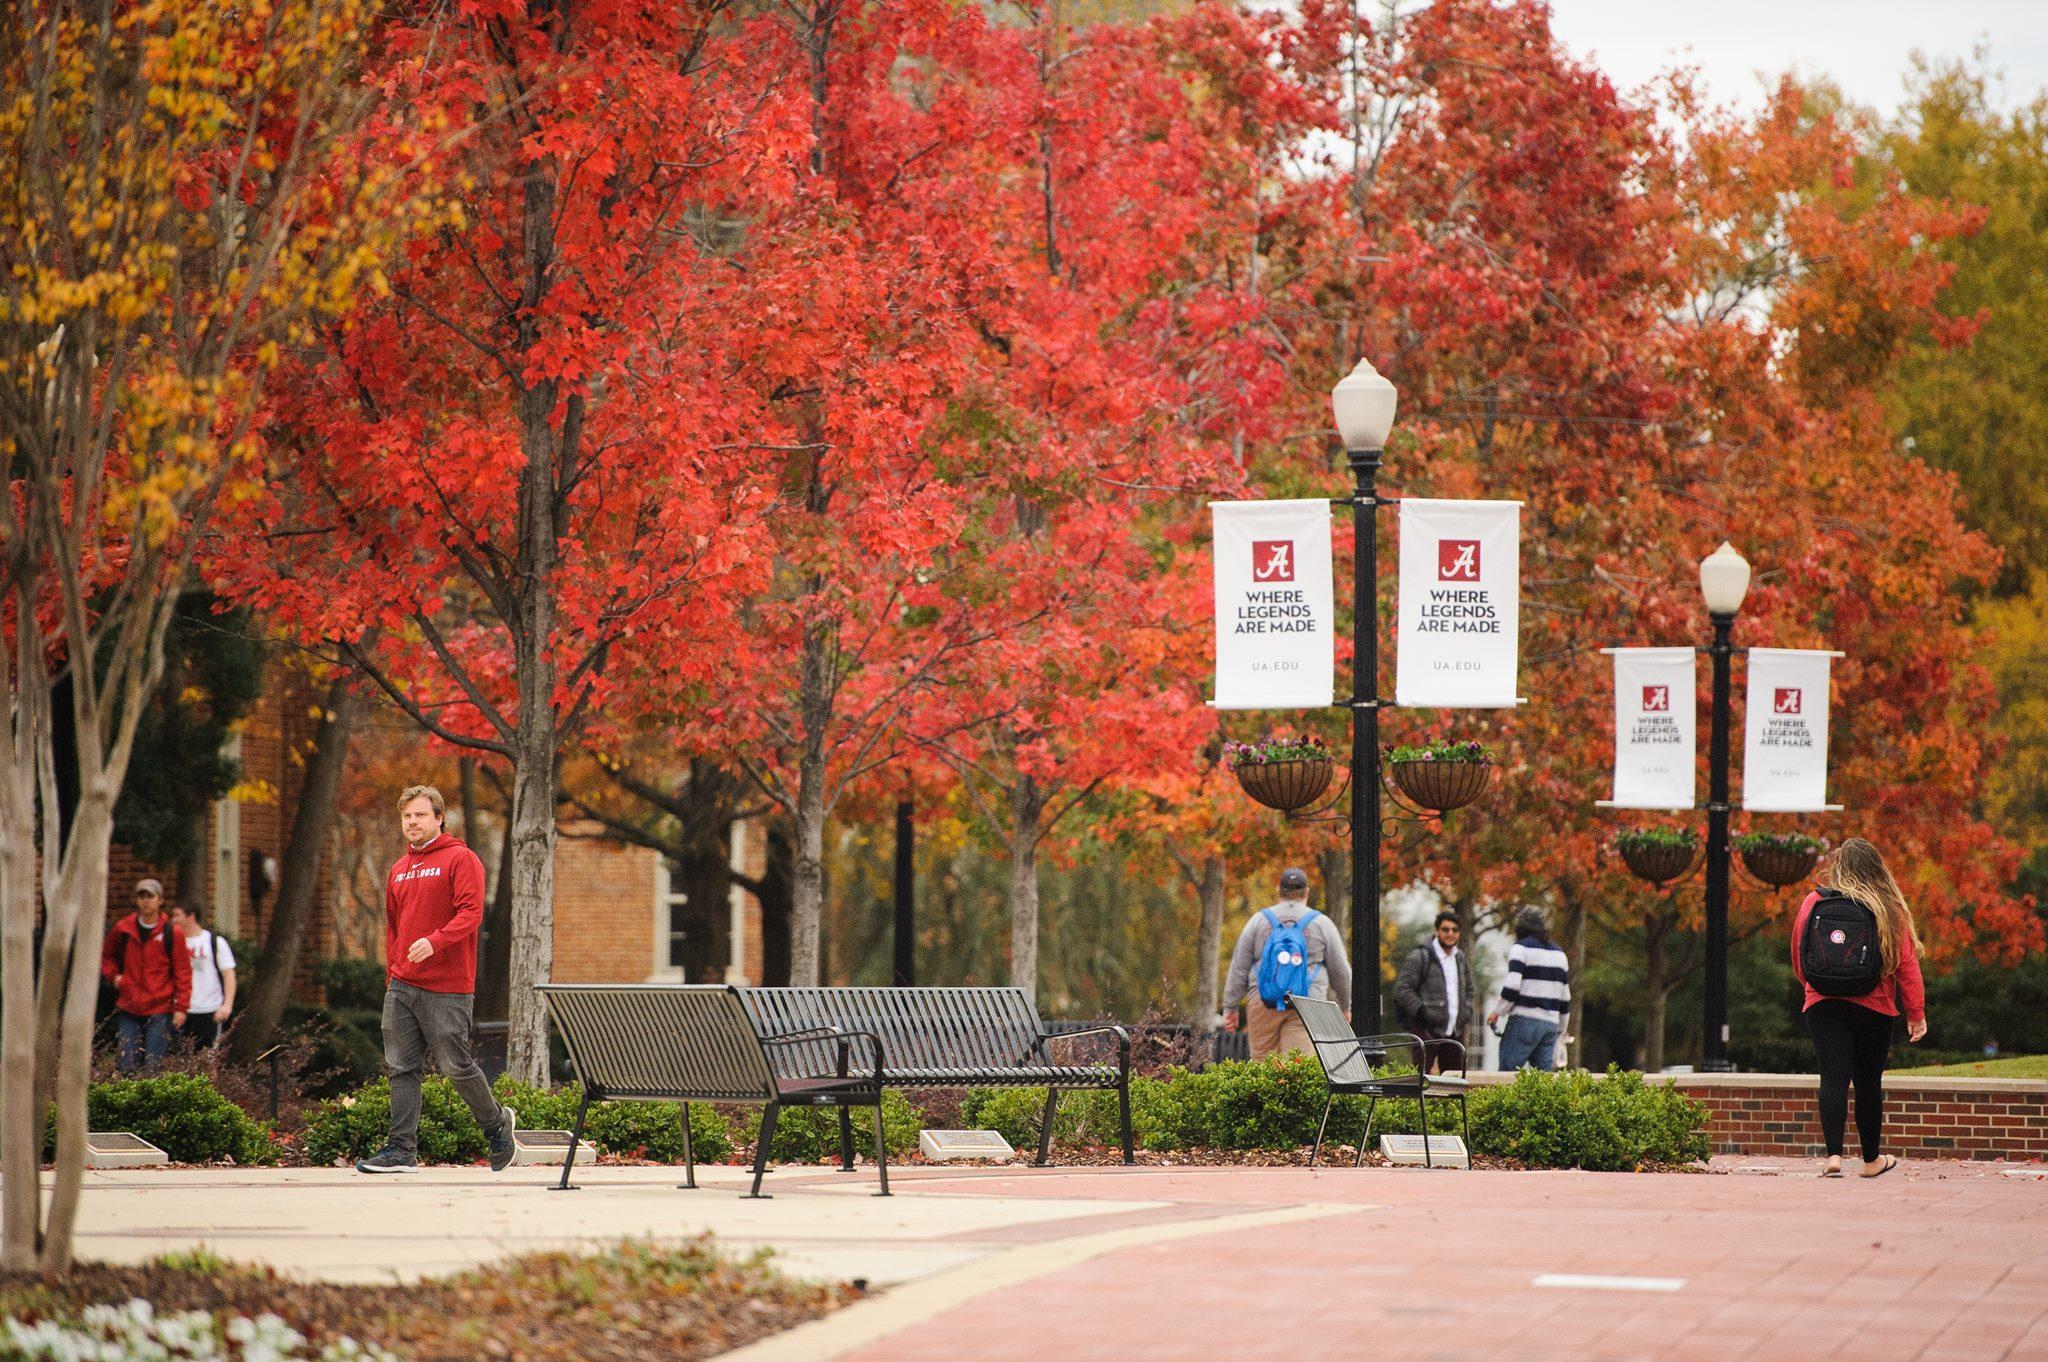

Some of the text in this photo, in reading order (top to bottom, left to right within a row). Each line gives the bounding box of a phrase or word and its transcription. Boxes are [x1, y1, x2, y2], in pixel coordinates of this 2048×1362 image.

[1255, 544, 1291, 579] A
[1441, 544, 1477, 578] A
[1245, 590, 1304, 603] WHERE
[1429, 590, 1489, 603] WHERE
[1238, 605, 1311, 619] LEGENDS
[1421, 604, 1496, 618] LEGENDS
[1234, 620, 1316, 634] ARE MADE
[1416, 619, 1501, 633] ARE MADE
[1252, 661, 1299, 671] UA.EDU
[1433, 661, 1482, 671] UA.EDU
[1768, 719, 1806, 727] WHERE
[1632, 726, 1679, 734] LEGENDS
[1762, 728, 1810, 737] LEGENDS
[1783, 739, 1812, 747] MADE
